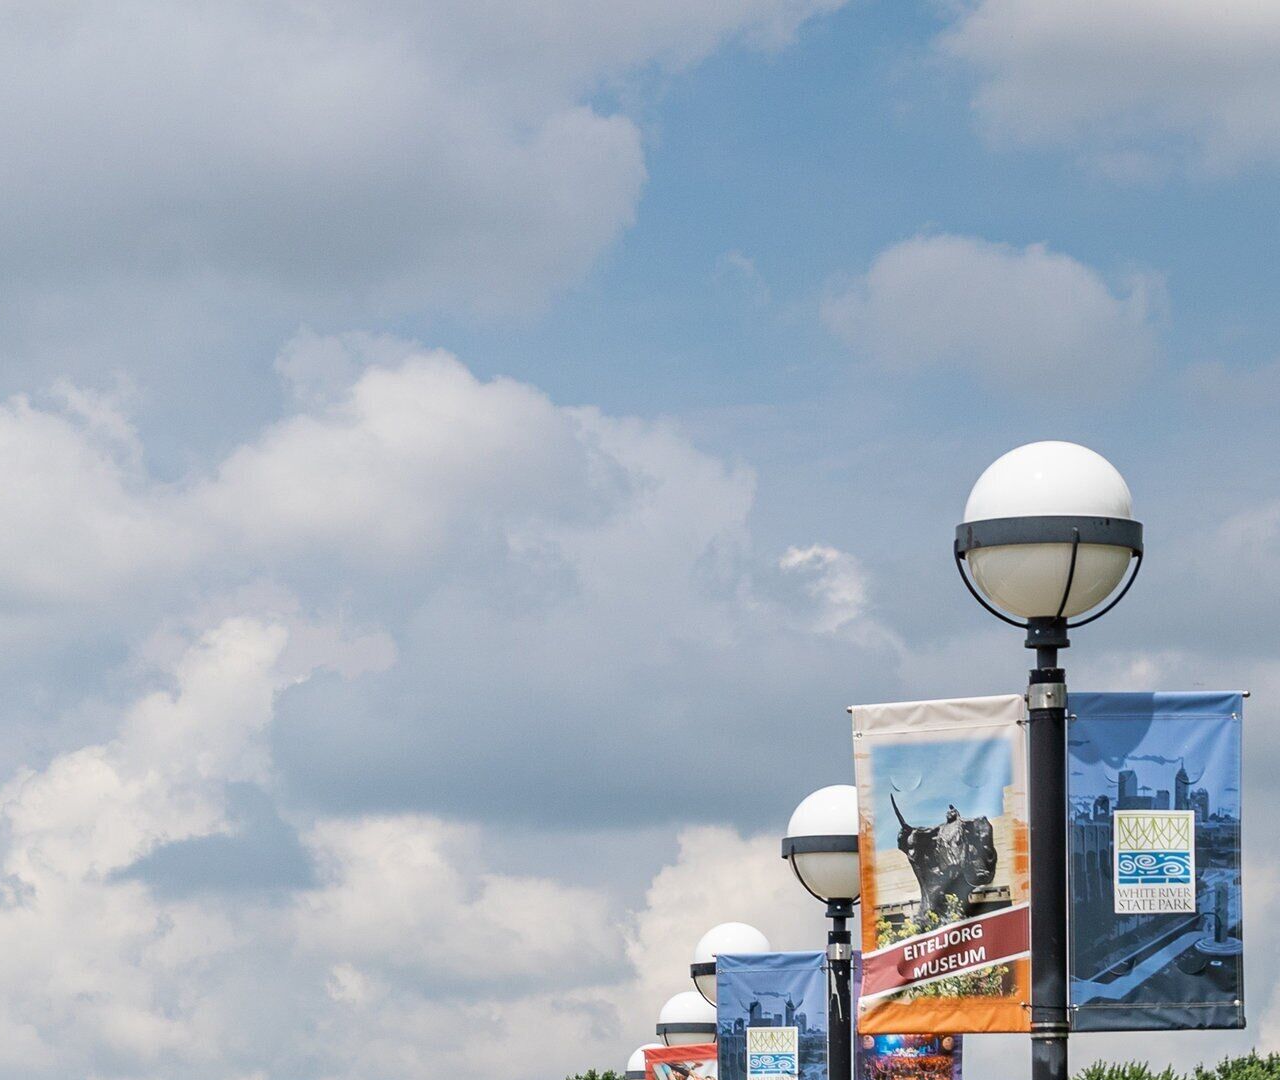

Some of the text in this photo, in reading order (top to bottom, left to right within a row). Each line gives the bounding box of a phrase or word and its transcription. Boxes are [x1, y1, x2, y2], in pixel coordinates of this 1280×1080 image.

[1118, 887, 1193, 899] WHITE RIVER
[1118, 899, 1193, 911] STATE PARK
[903, 924, 983, 961] EITELJORG
[913, 946, 986, 978] MUSEUM
